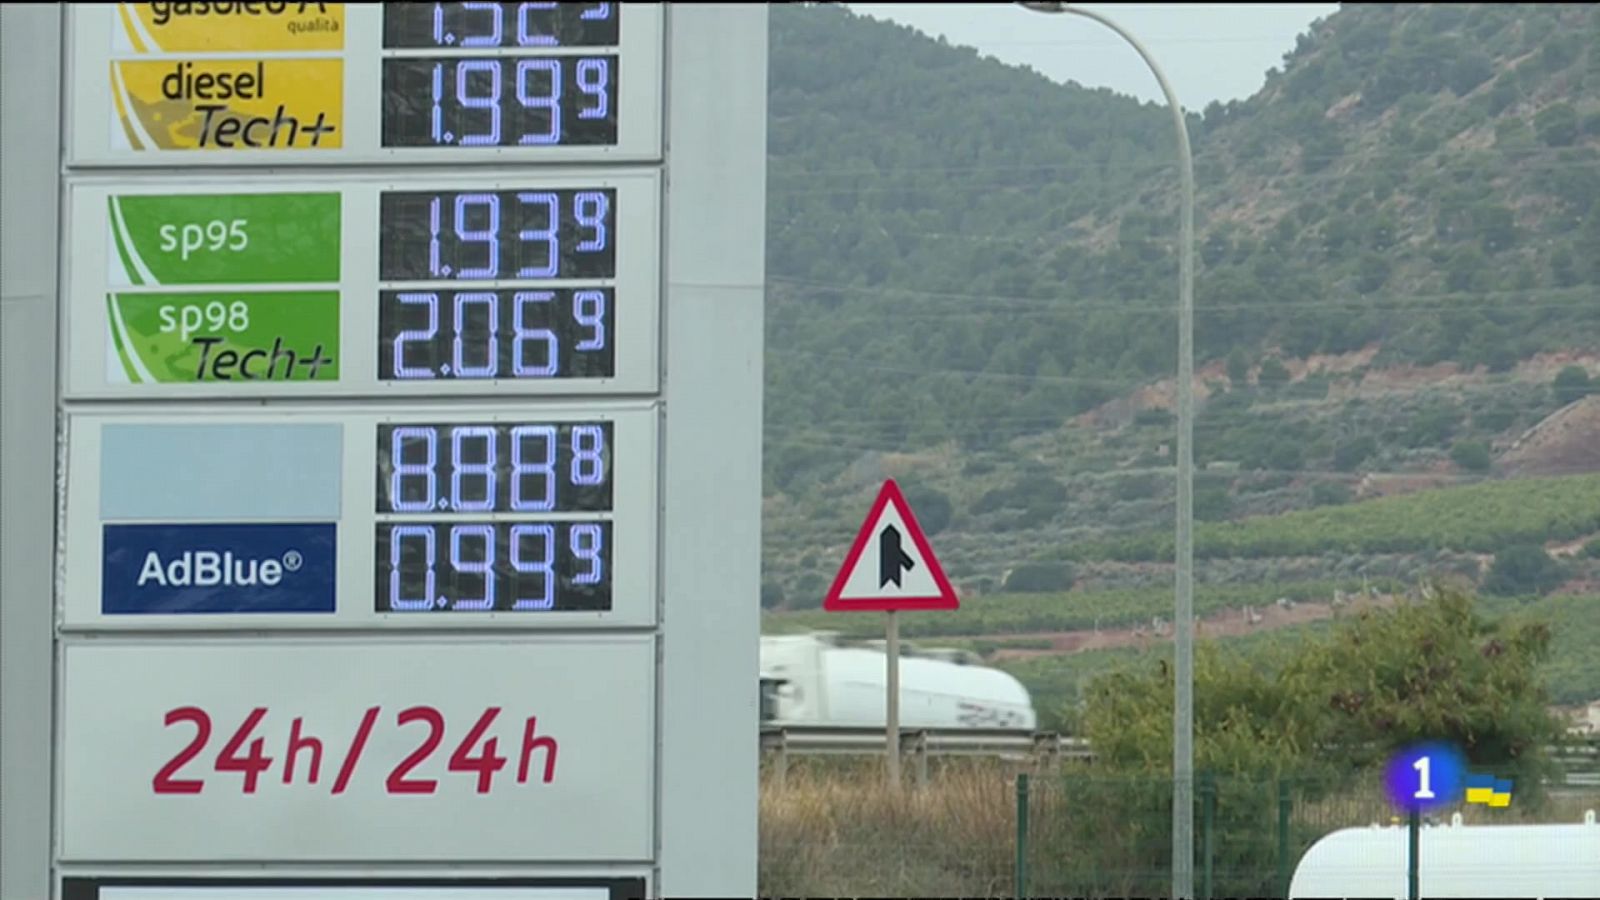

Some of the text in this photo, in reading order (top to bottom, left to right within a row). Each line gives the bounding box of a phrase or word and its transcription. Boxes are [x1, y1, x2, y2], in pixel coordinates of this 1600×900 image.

[161, 61, 264, 100] diesel
[194, 105, 336, 148] Tech+
[159, 220, 249, 261] sp95
[158, 300, 250, 342] sp98
[193, 336, 333, 381] Tech+
